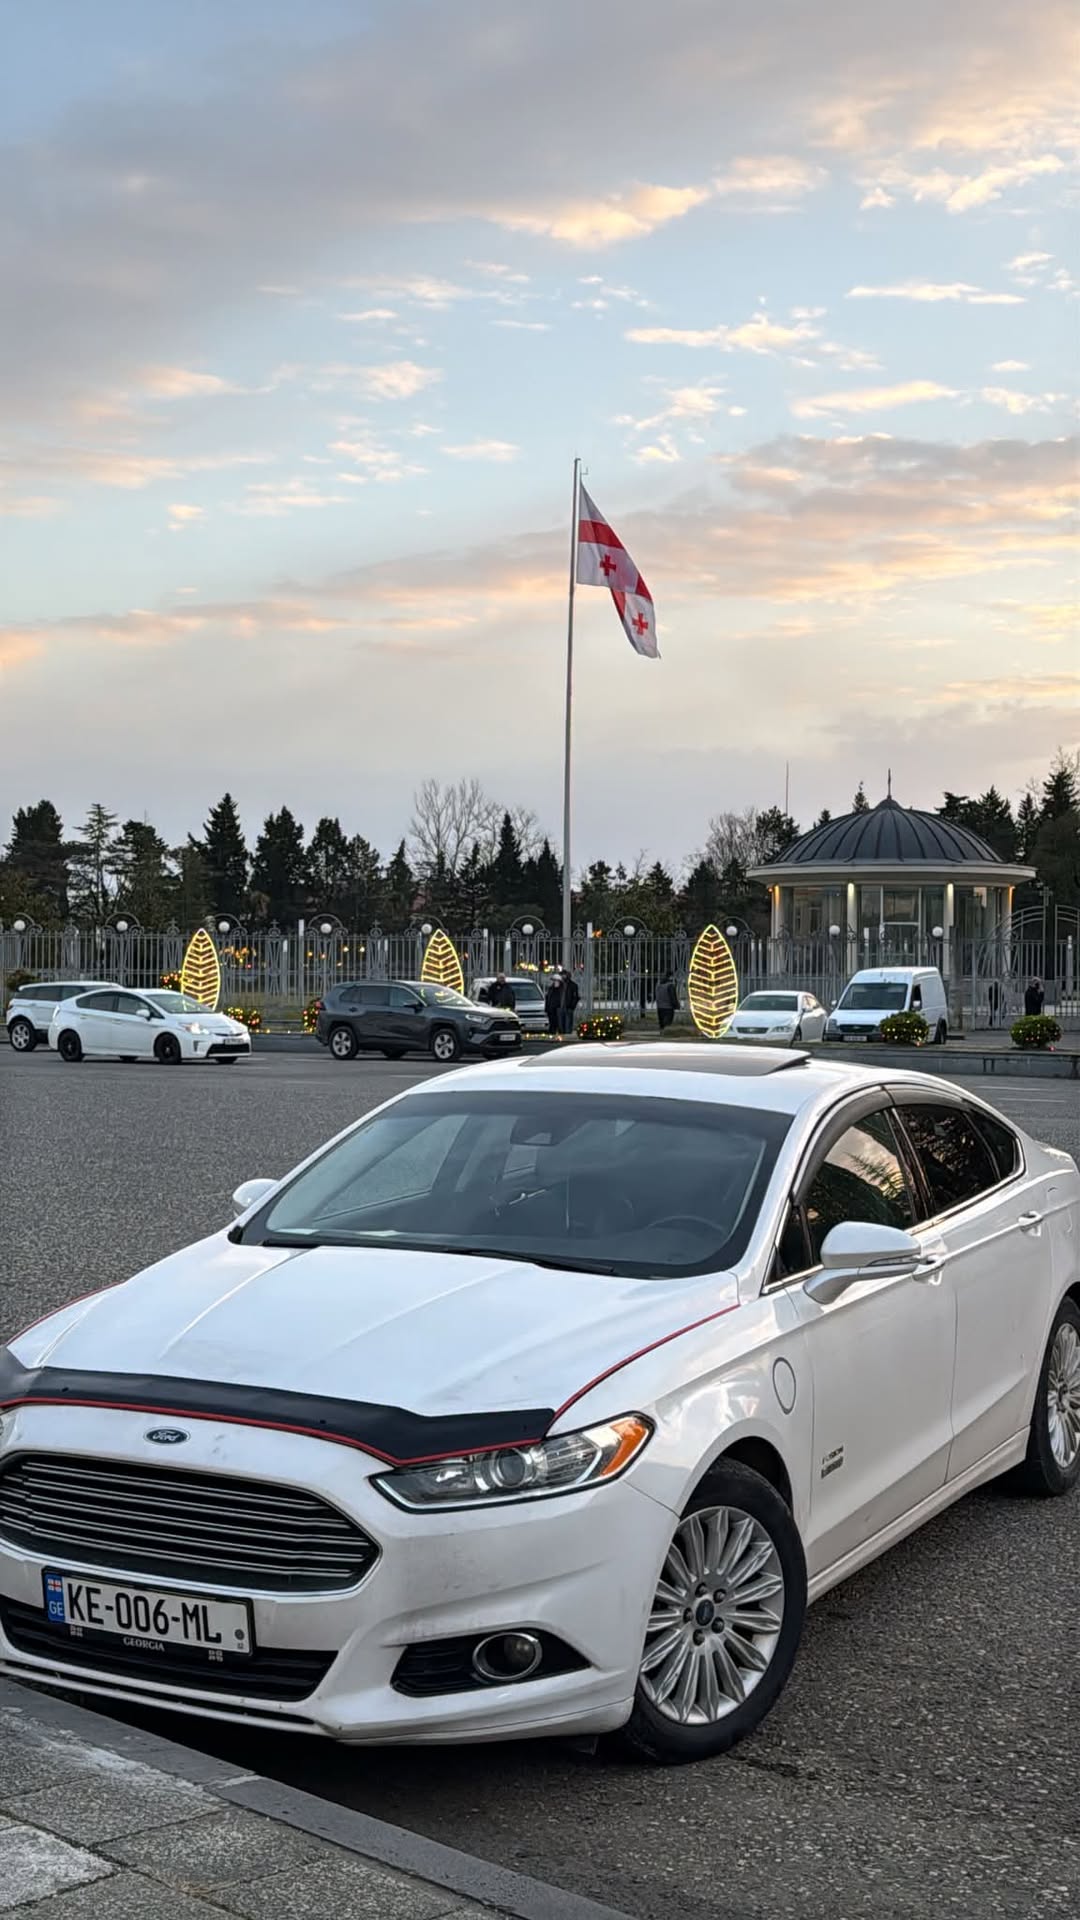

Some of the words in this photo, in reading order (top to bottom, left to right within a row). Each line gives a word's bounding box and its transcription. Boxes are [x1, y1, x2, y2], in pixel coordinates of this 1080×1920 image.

[152, 1430, 180, 1441] Ford
[49, 1600, 64, 1617] GE
[67, 1583, 222, 1644] KE-006-ML
[122, 1636, 165, 1651] GEORGIA
